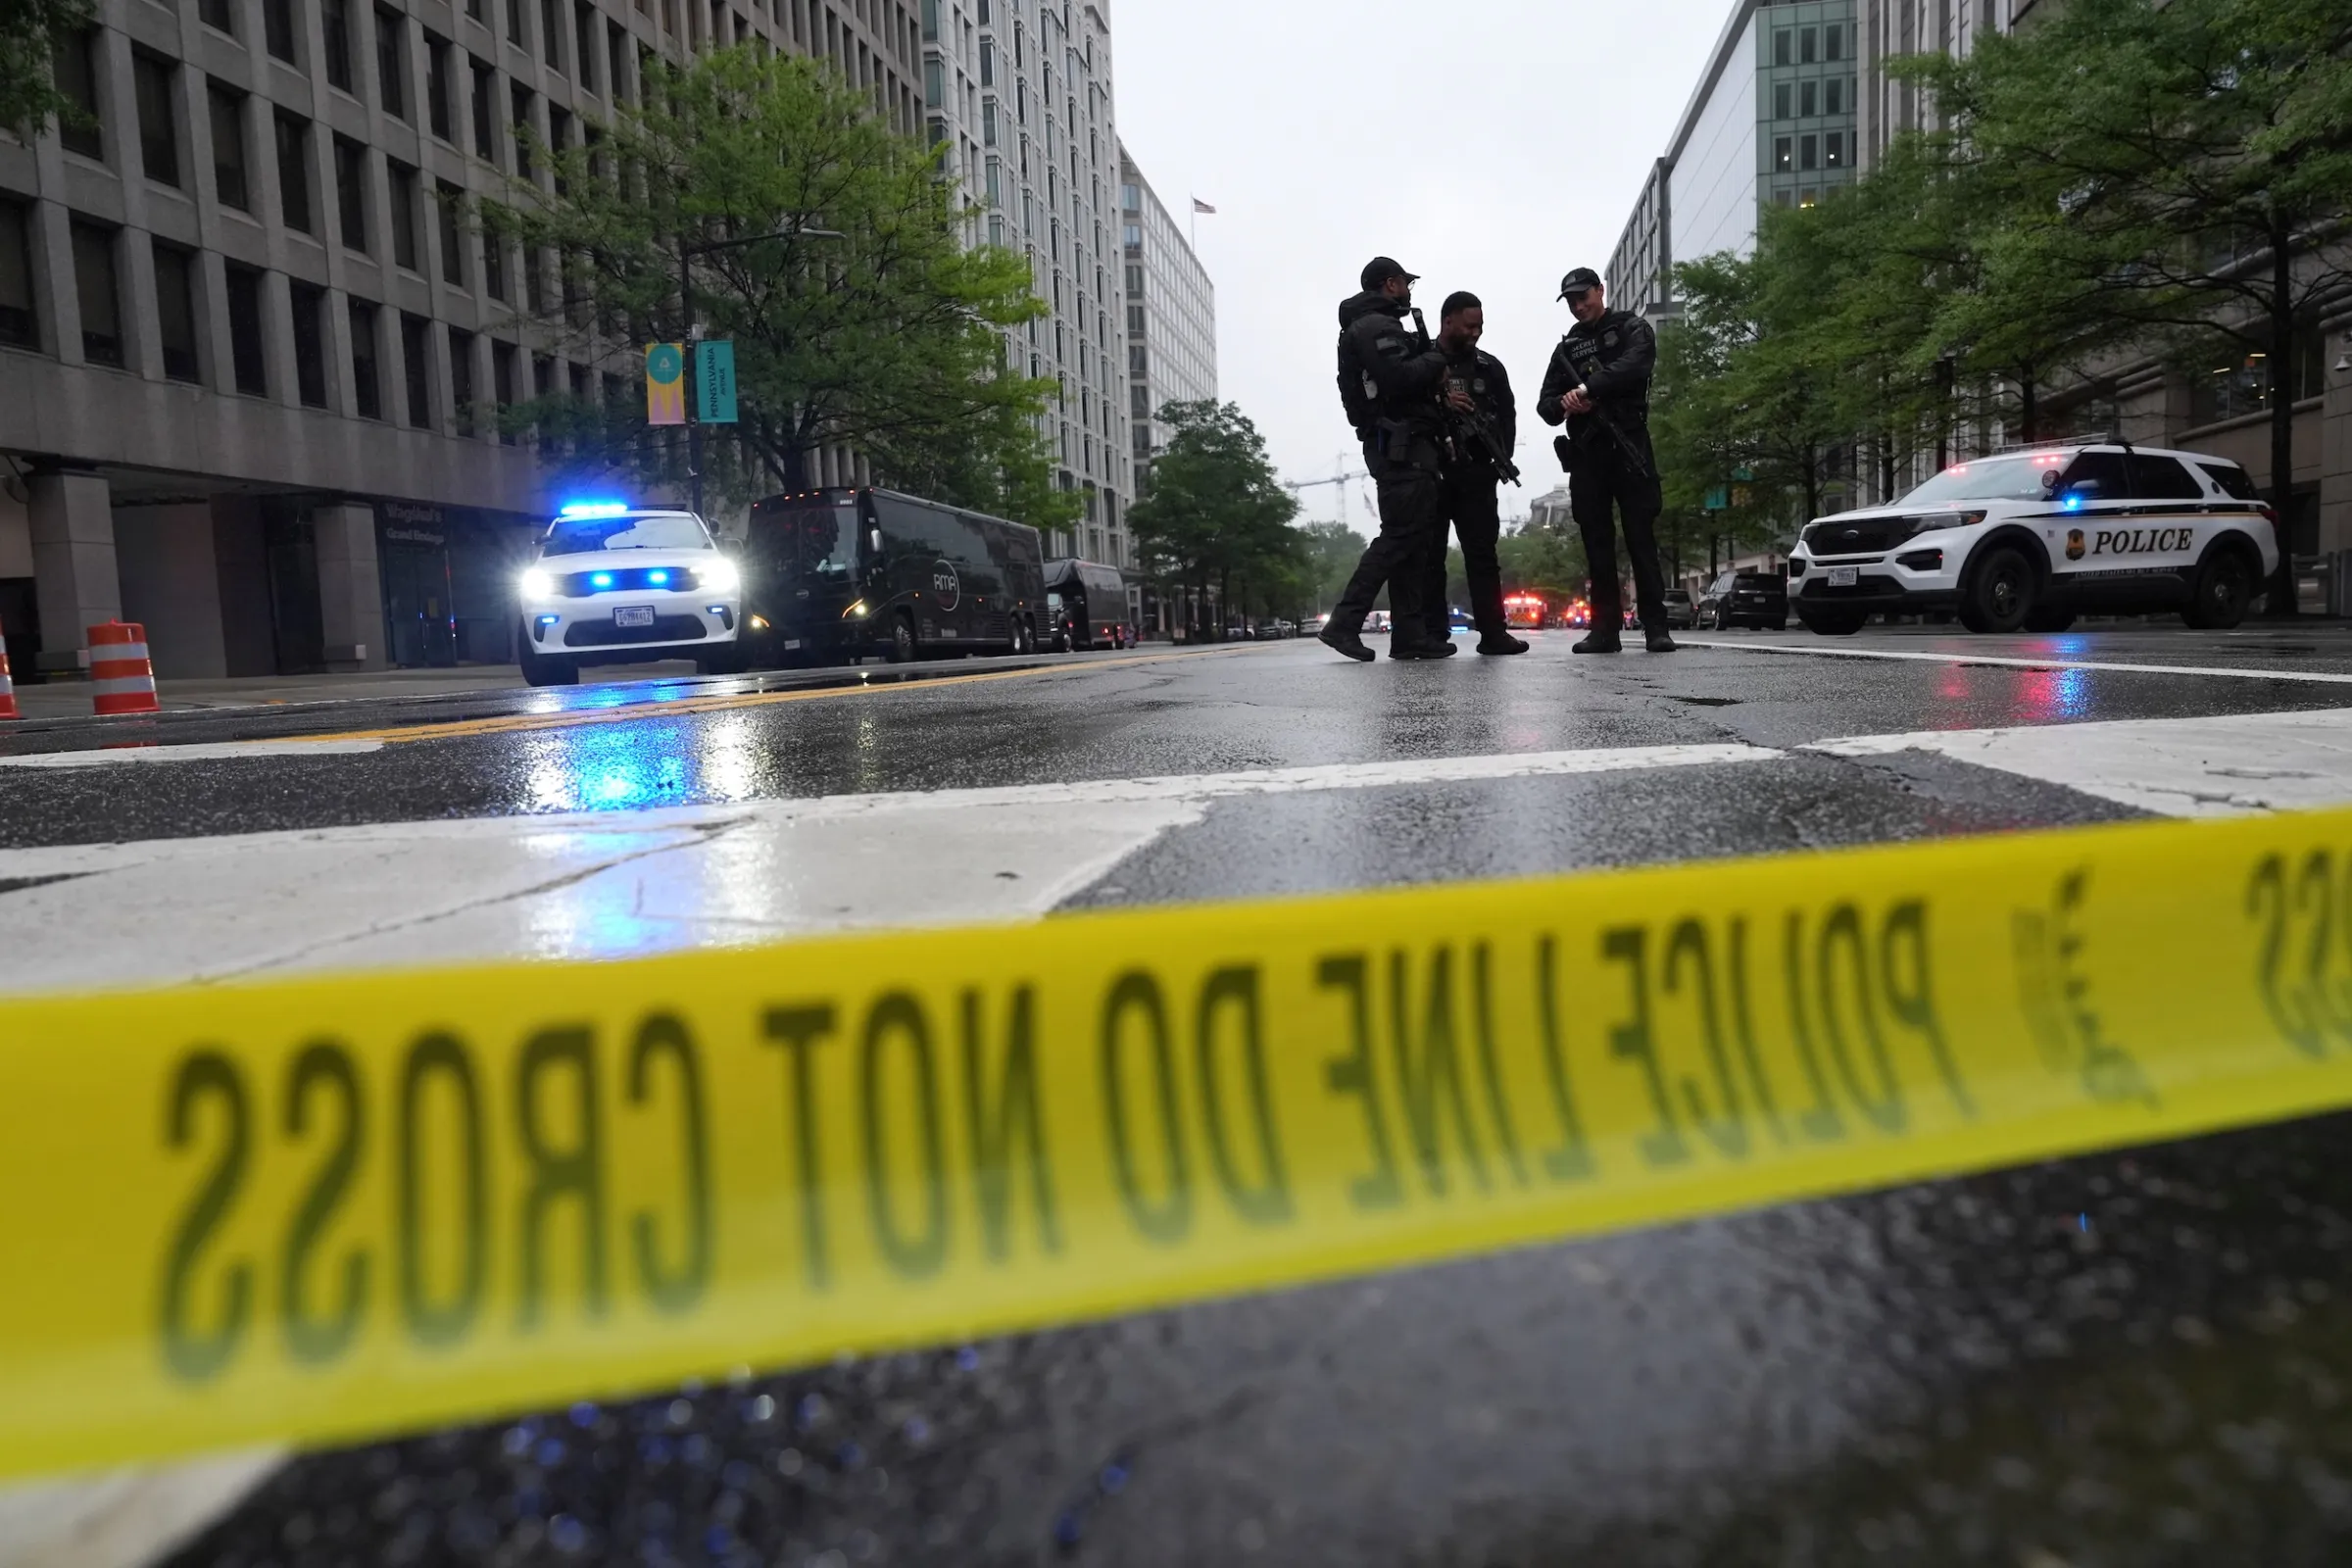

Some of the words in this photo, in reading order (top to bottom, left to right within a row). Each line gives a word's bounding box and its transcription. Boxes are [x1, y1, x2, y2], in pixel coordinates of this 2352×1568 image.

[1571, 345, 1598, 360] SERVICE
[707, 347, 719, 417] PENNSYLVANIA
[718, 368, 727, 397] AVENUE
[2092, 528, 2193, 555] POLICE
[933, 573, 956, 591] RMA
